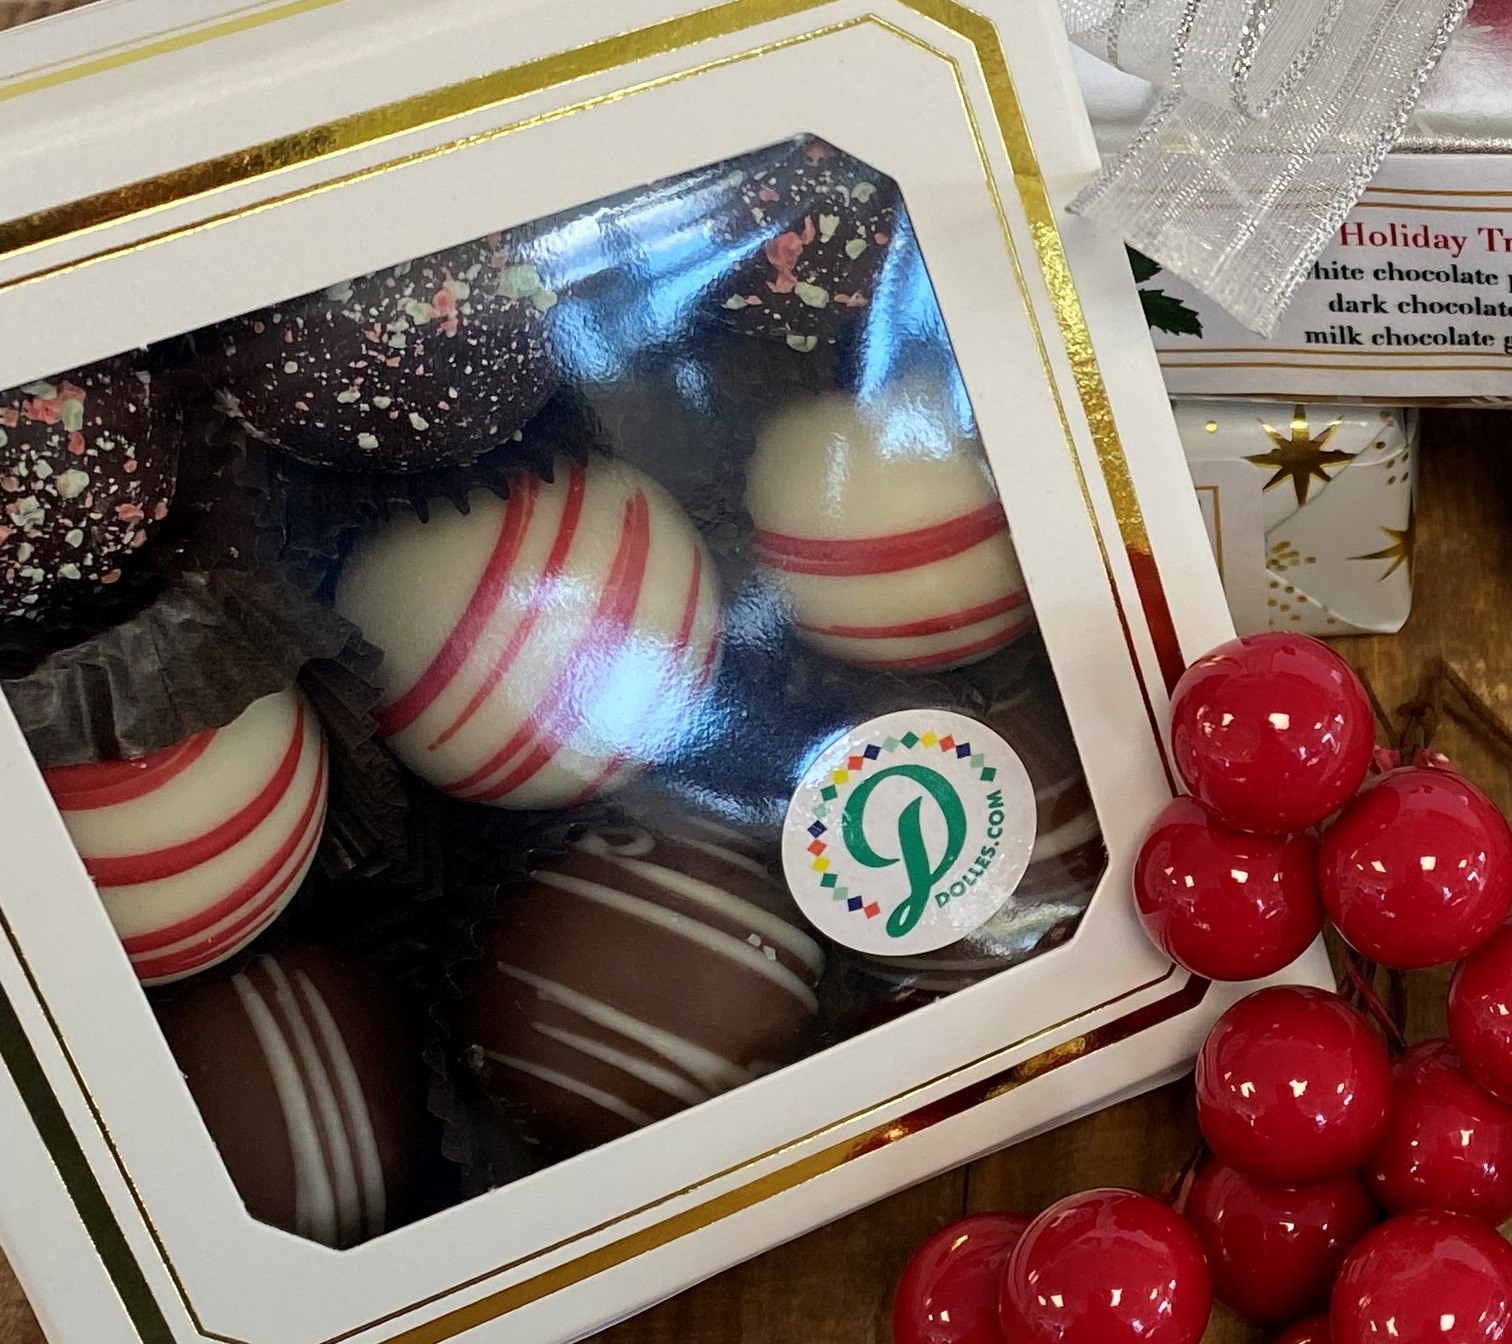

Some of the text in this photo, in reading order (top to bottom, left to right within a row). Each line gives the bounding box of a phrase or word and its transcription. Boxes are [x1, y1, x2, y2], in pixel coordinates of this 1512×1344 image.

[1339, 221, 1468, 258] Holiday
[1306, 260, 1364, 280] hite
[1373, 261, 1499, 285] chocolate
[1328, 292, 1390, 314] dark
[1304, 325, 1364, 345] milk
[1371, 326, 1495, 346] chocolate
[935, 789, 1005, 908] DOLLES.COM
